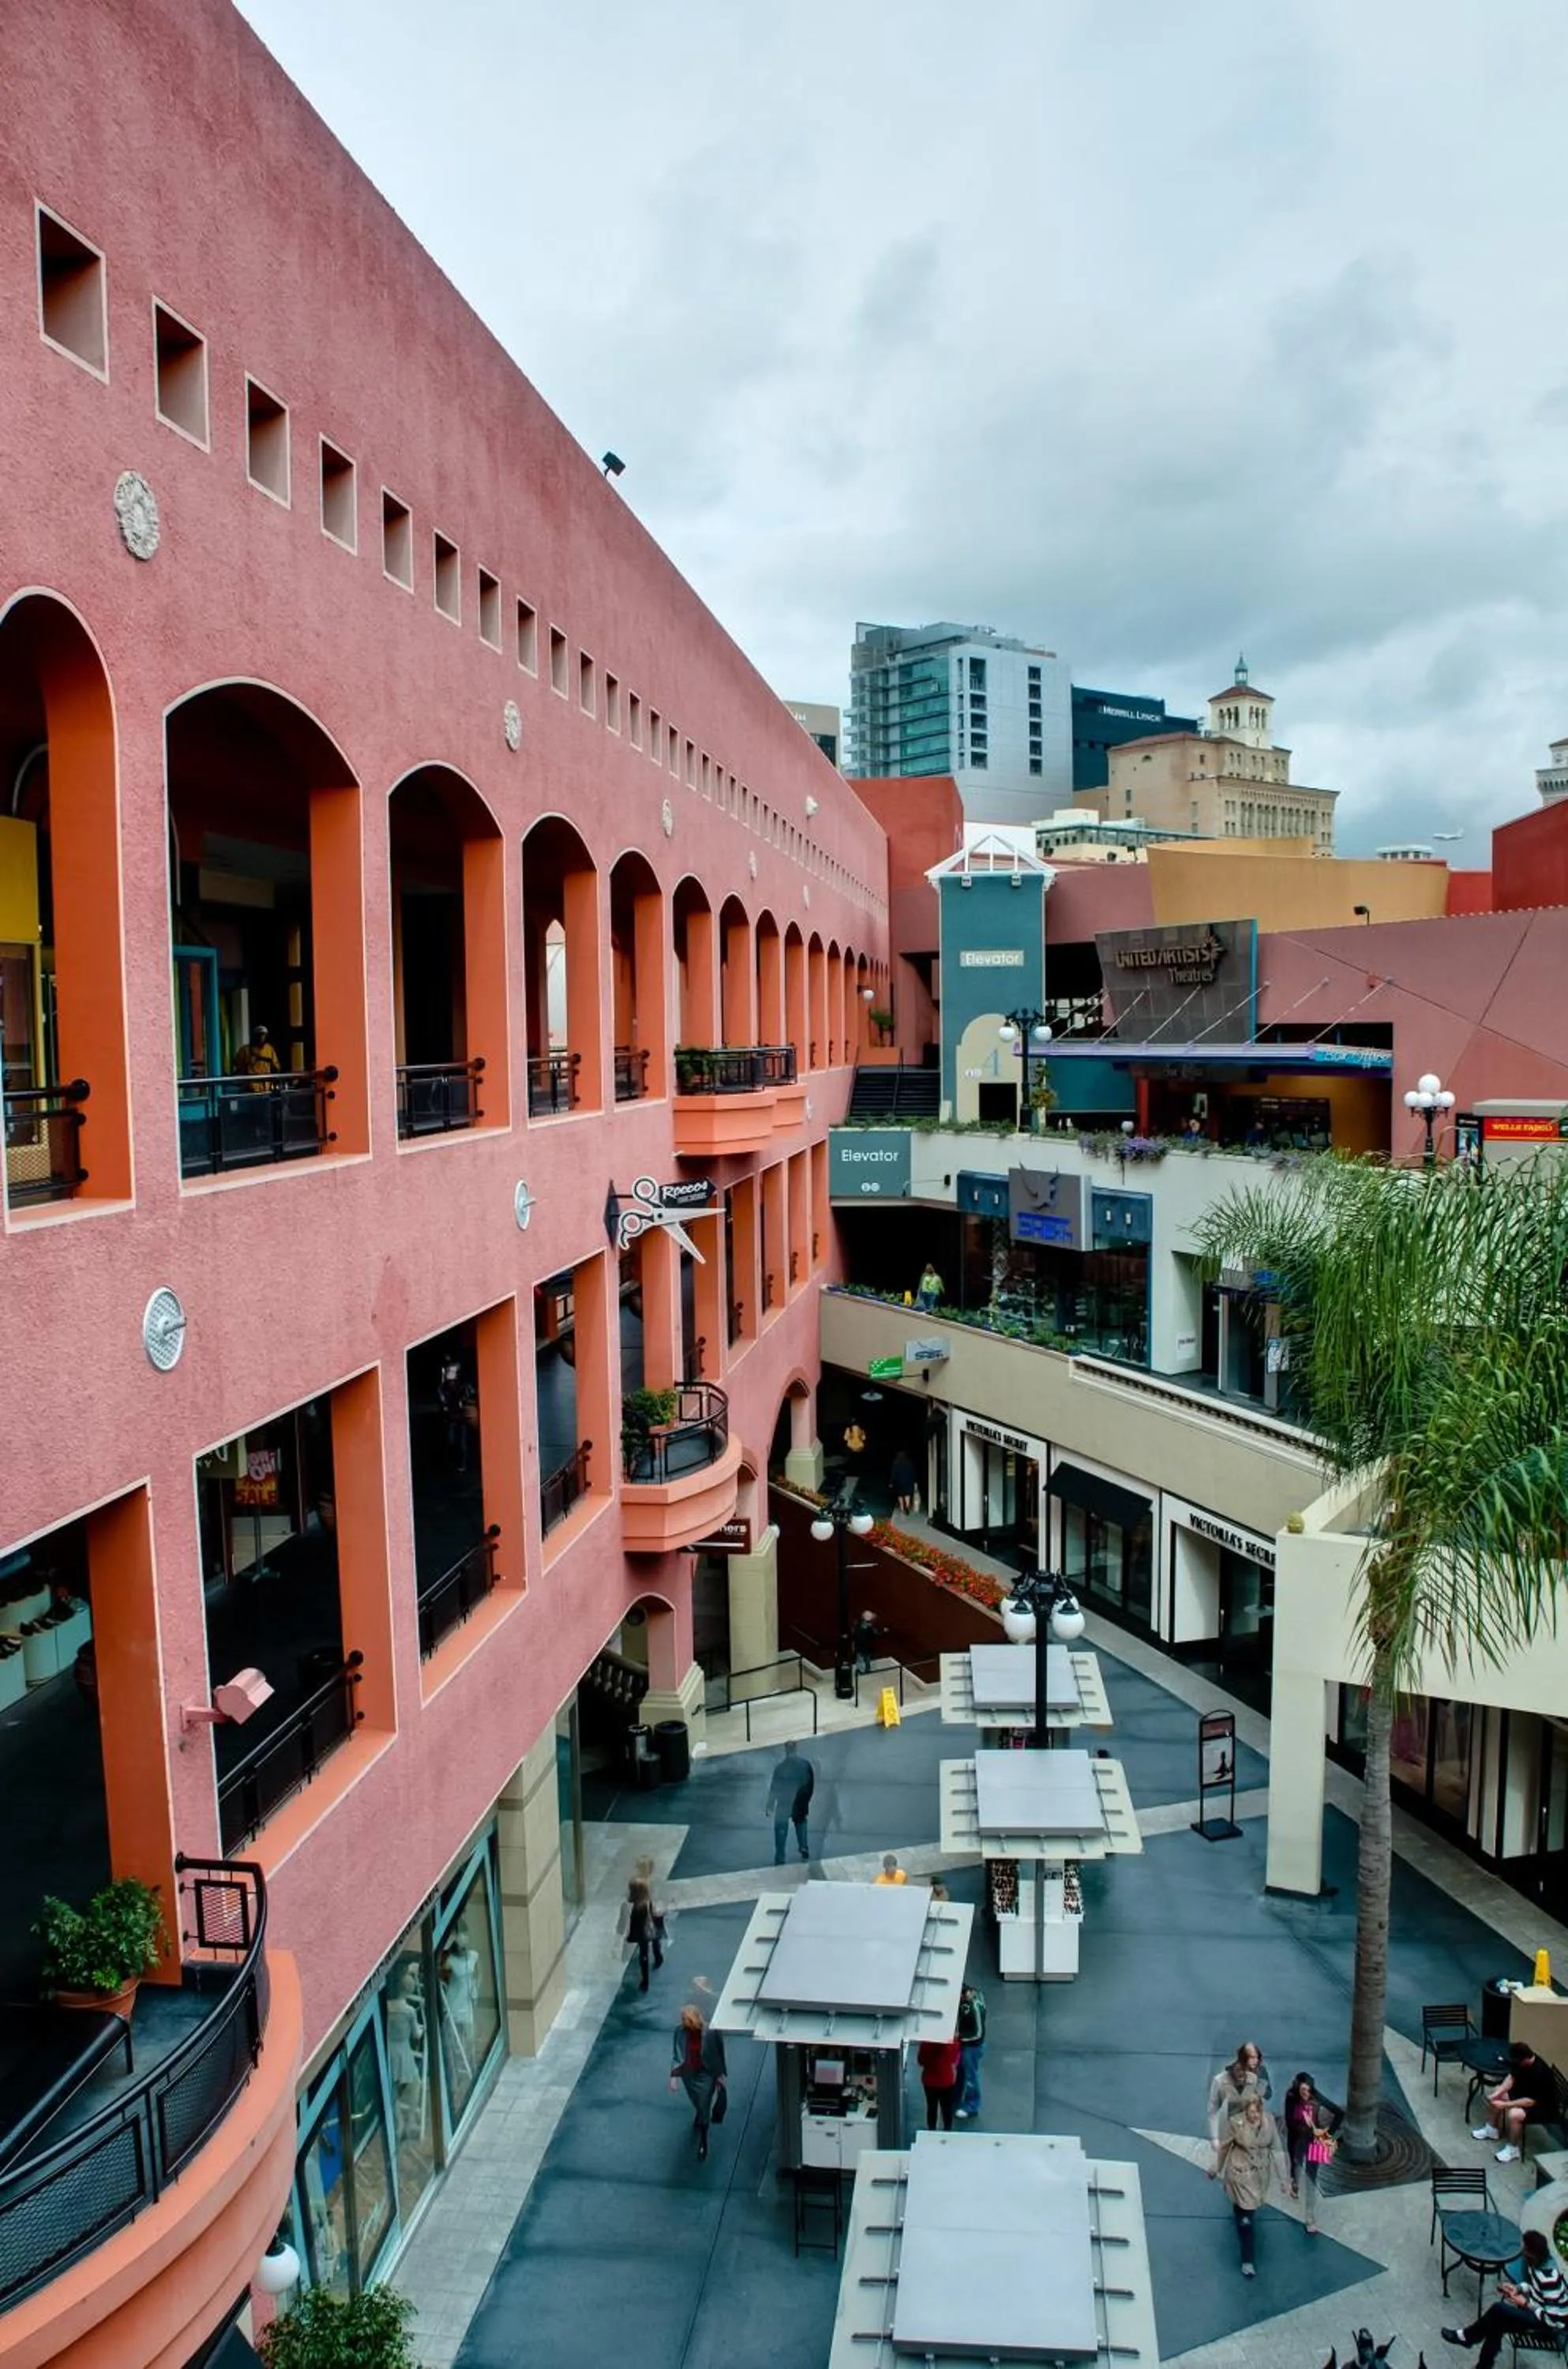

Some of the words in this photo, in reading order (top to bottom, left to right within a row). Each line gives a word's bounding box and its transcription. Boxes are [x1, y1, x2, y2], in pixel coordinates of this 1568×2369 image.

[965, 952, 1020, 965] Elevator
[841, 1149, 899, 1162] Elevator
[1189, 1512, 1244, 1551] VICTORIA'S
[1244, 1541, 1277, 1567] SECRE
